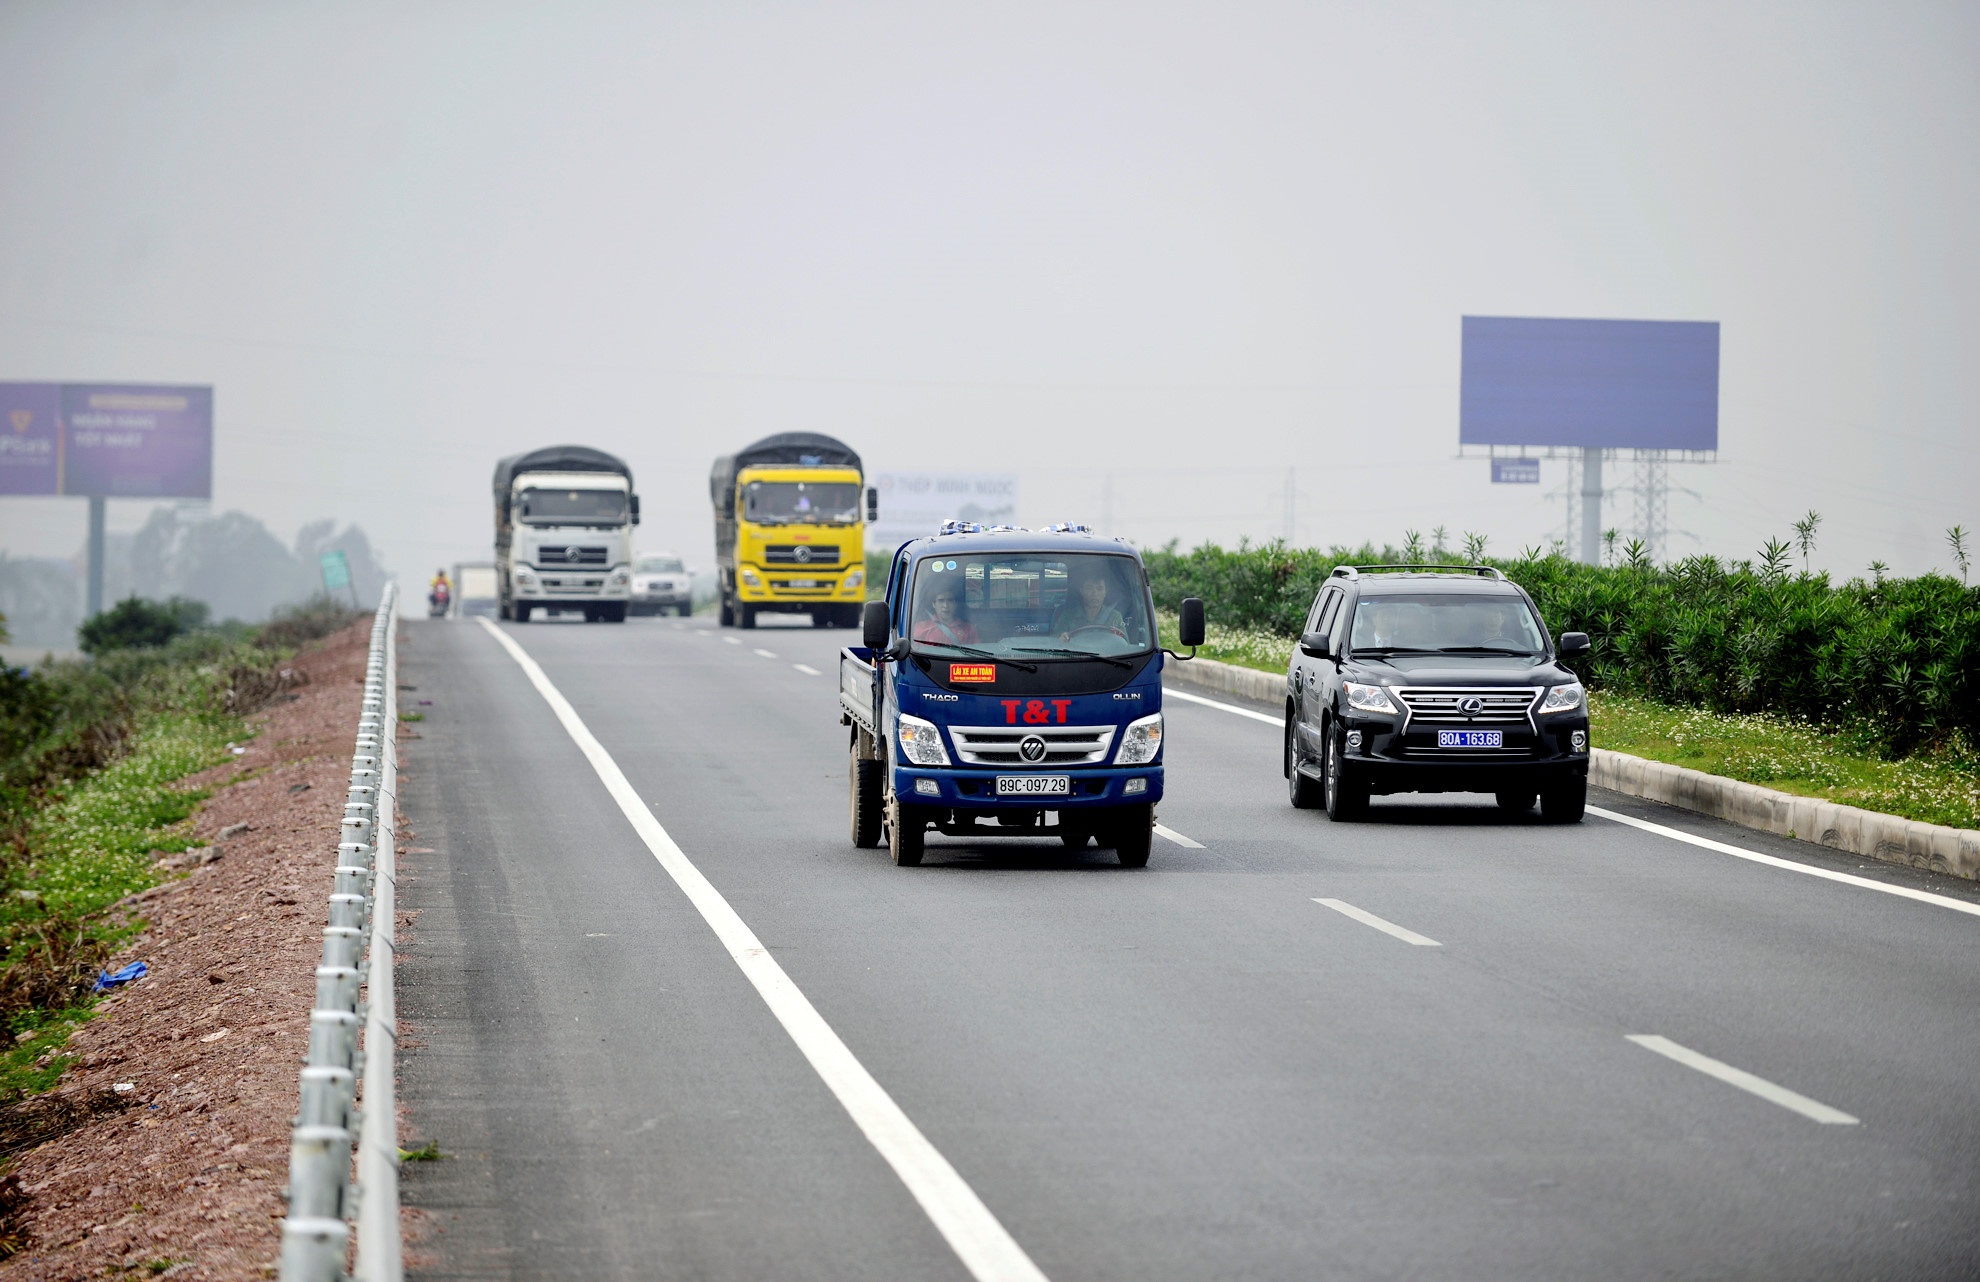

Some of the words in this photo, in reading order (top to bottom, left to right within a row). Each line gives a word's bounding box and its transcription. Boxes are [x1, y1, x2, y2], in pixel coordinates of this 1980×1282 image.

[922, 693, 959, 702] THACO
[1000, 700, 1072, 724] T&T
[1440, 733, 1500, 745] 80A-163.68
[999, 777, 1067, 793] 89C-097.29
